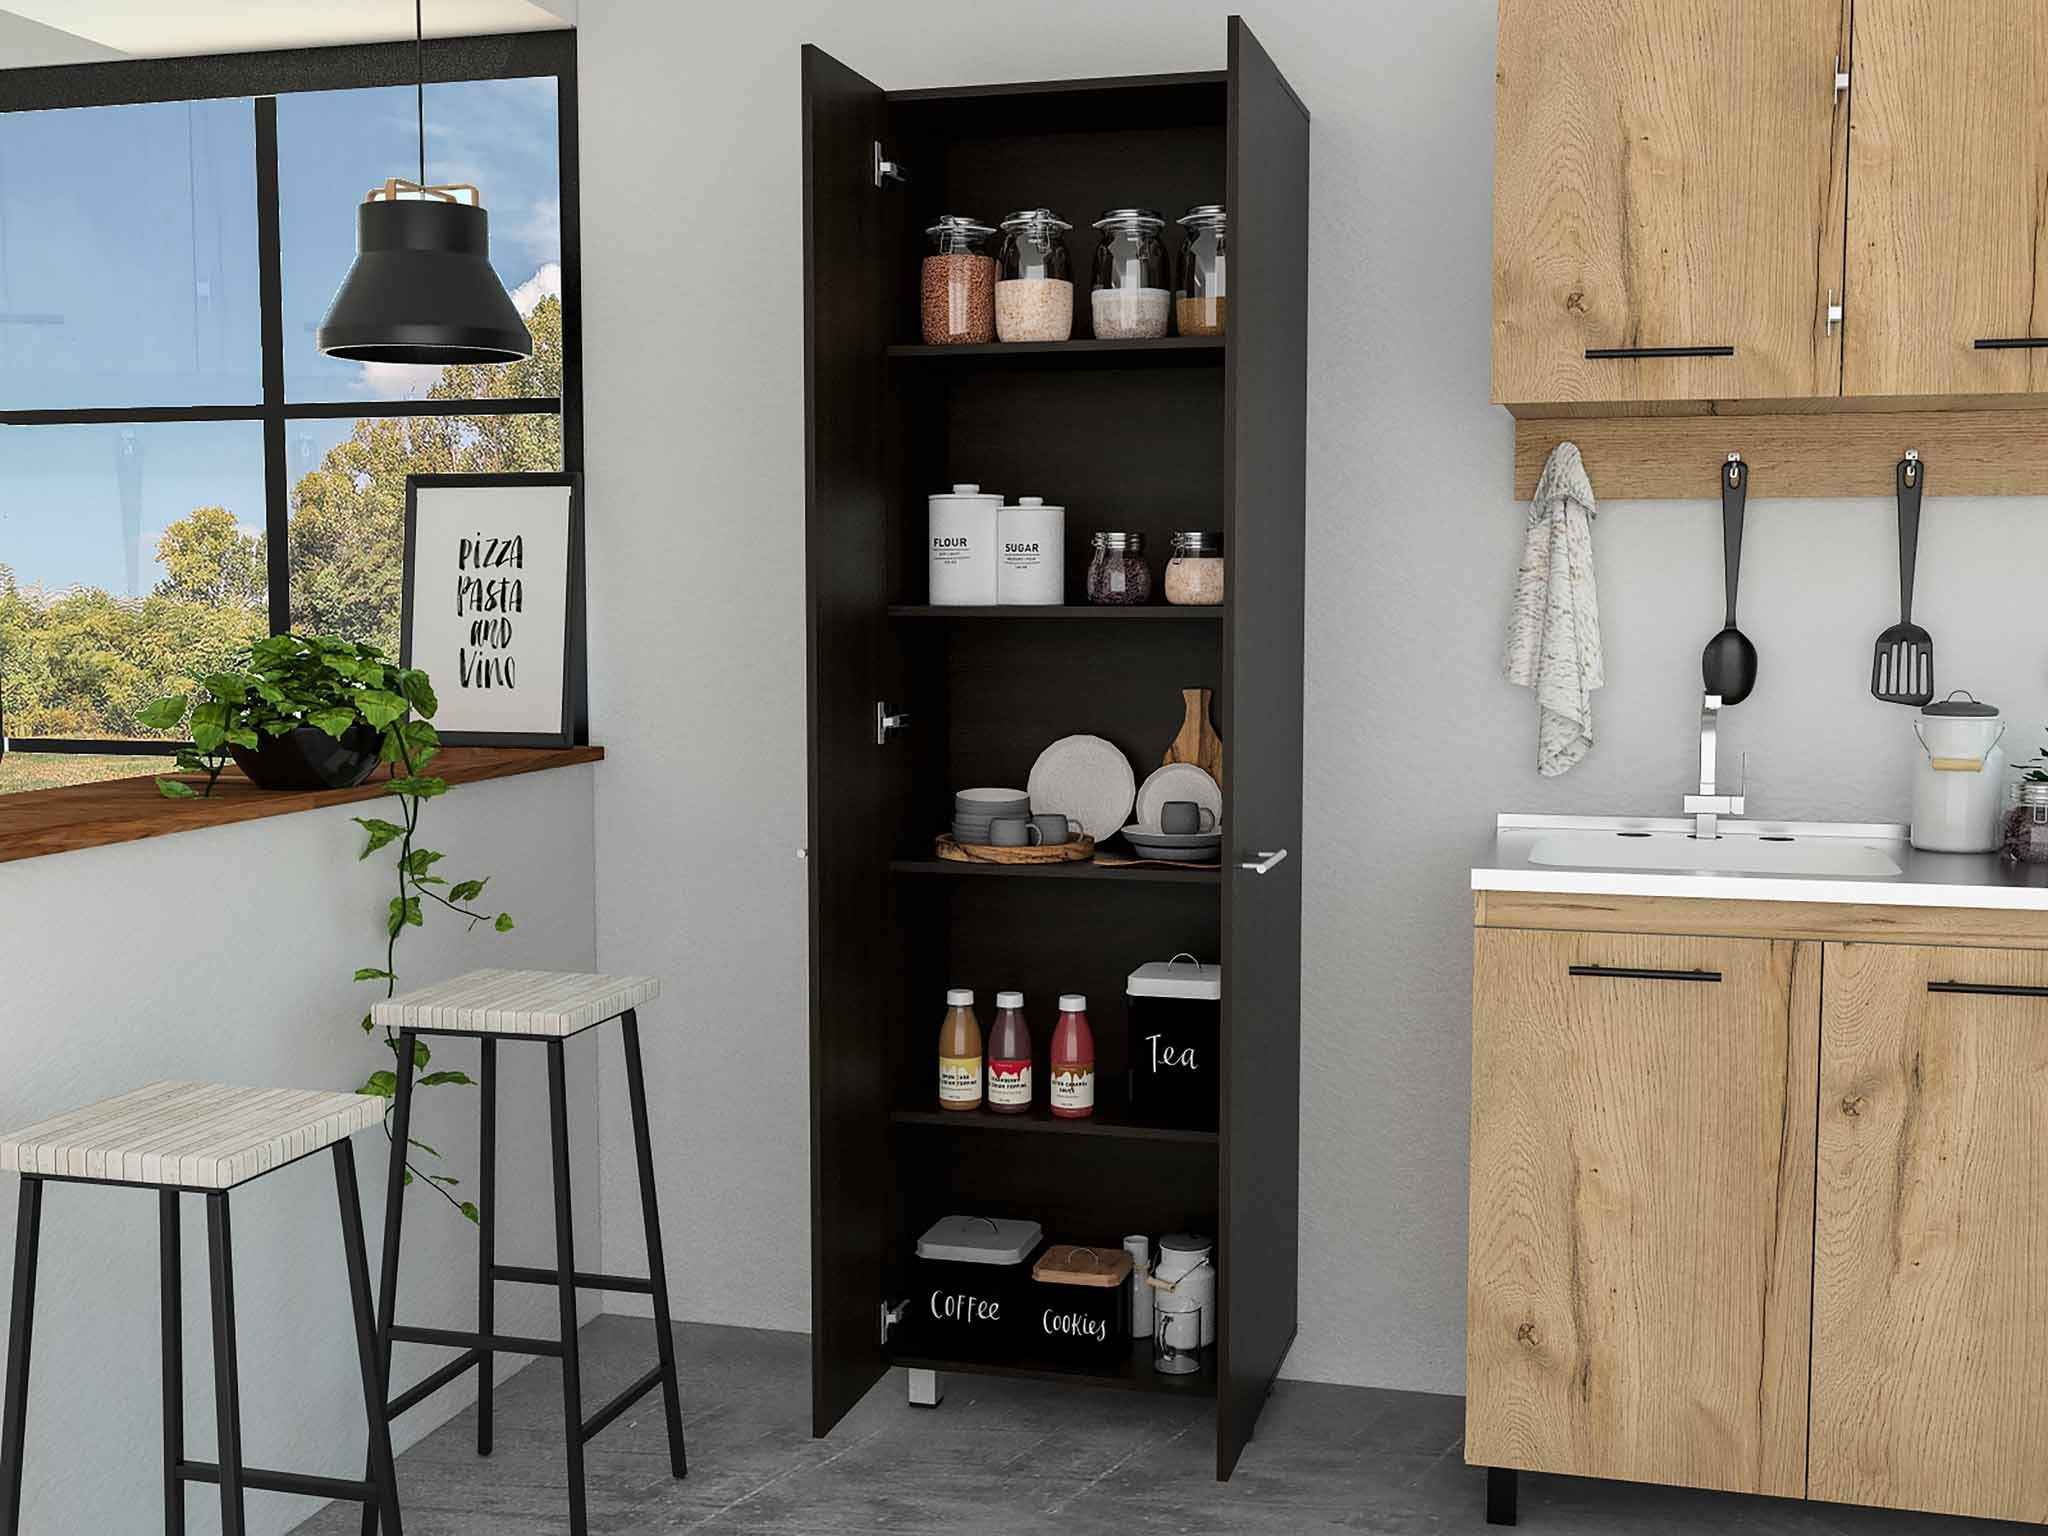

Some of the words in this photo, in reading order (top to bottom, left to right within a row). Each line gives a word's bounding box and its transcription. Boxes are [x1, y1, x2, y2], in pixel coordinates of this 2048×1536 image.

[933, 538, 967, 547] FLOUR
[1005, 543, 1039, 552] SUGAR
[457, 575, 523, 617] PASTA
[459, 648, 516, 689] Vino
[1145, 1034, 1198, 1073] Tea
[1043, 1309, 1106, 1341] Cookies
